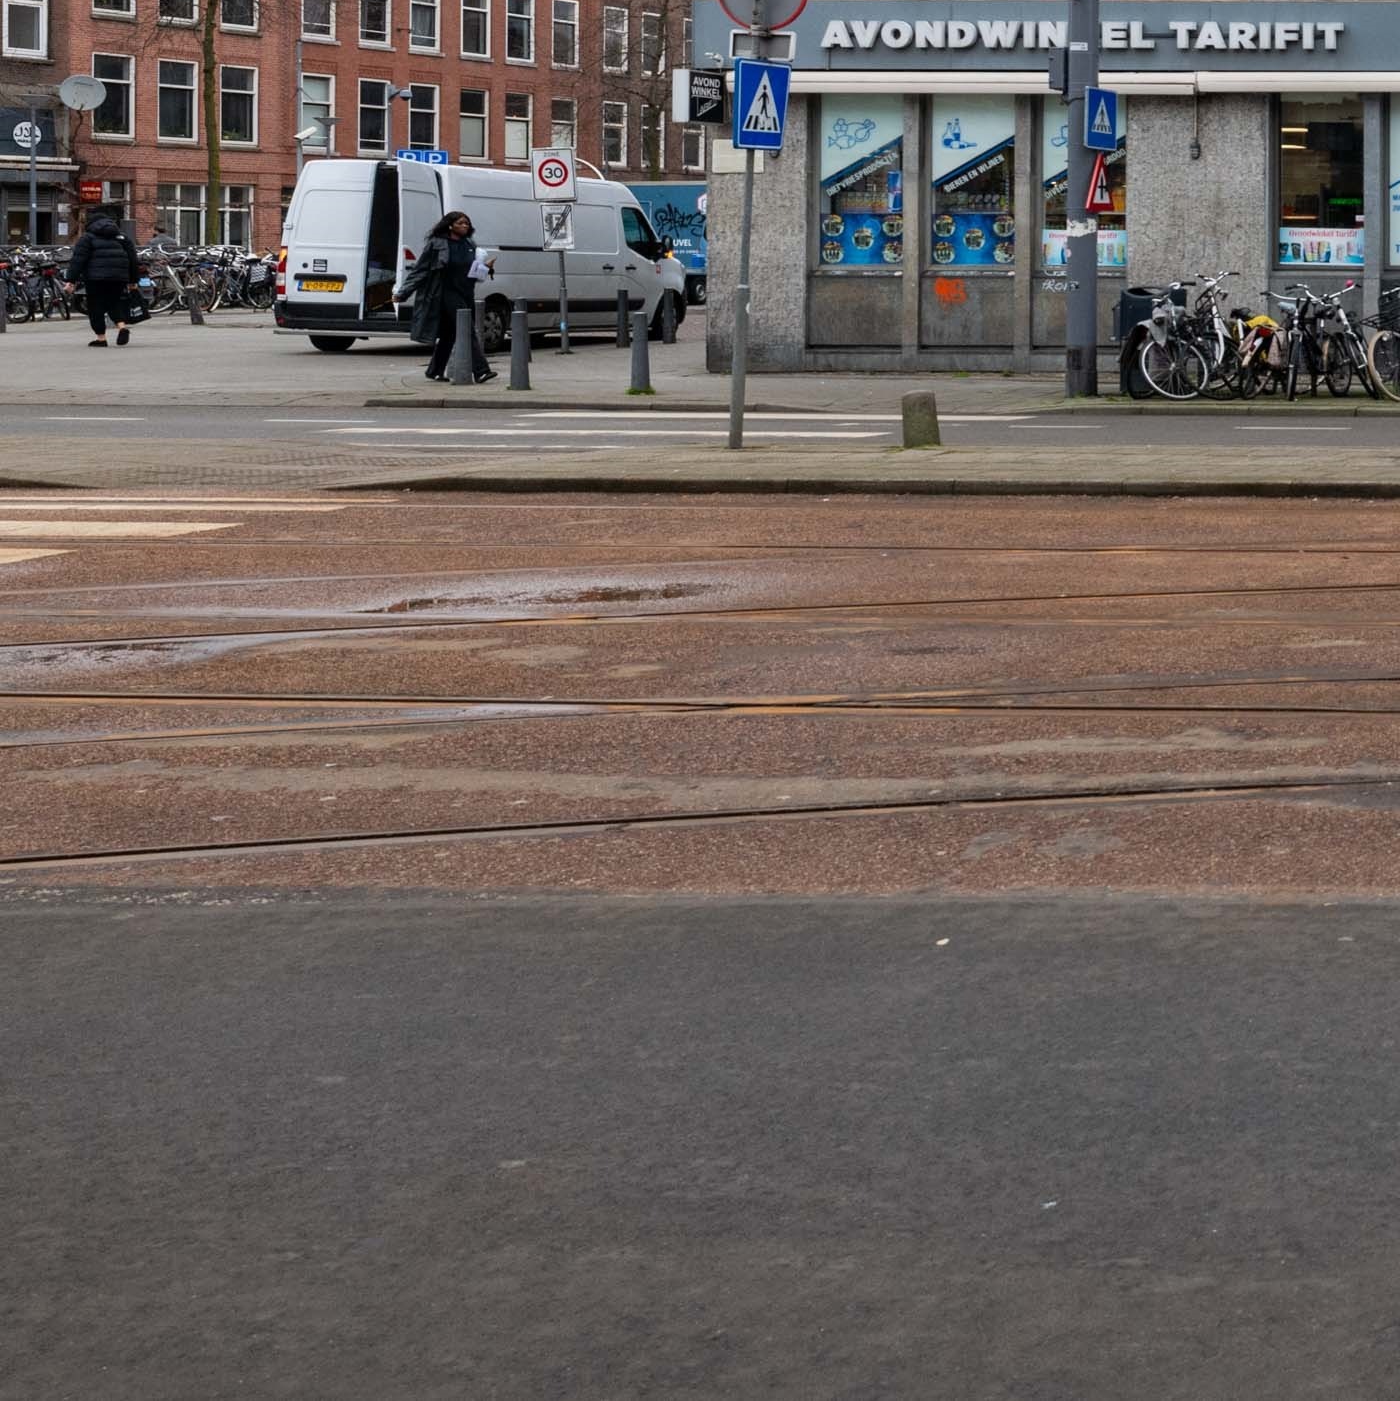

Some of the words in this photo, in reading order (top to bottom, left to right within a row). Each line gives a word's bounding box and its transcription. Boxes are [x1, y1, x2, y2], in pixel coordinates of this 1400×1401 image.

[820, 20, 1156, 49] AVONDWINEL
[1168, 21, 1345, 50] TARIFIT
[693, 76, 721, 88] AVOND
[691, 85, 722, 98] WINKEL
[544, 167, 563, 179] 30
